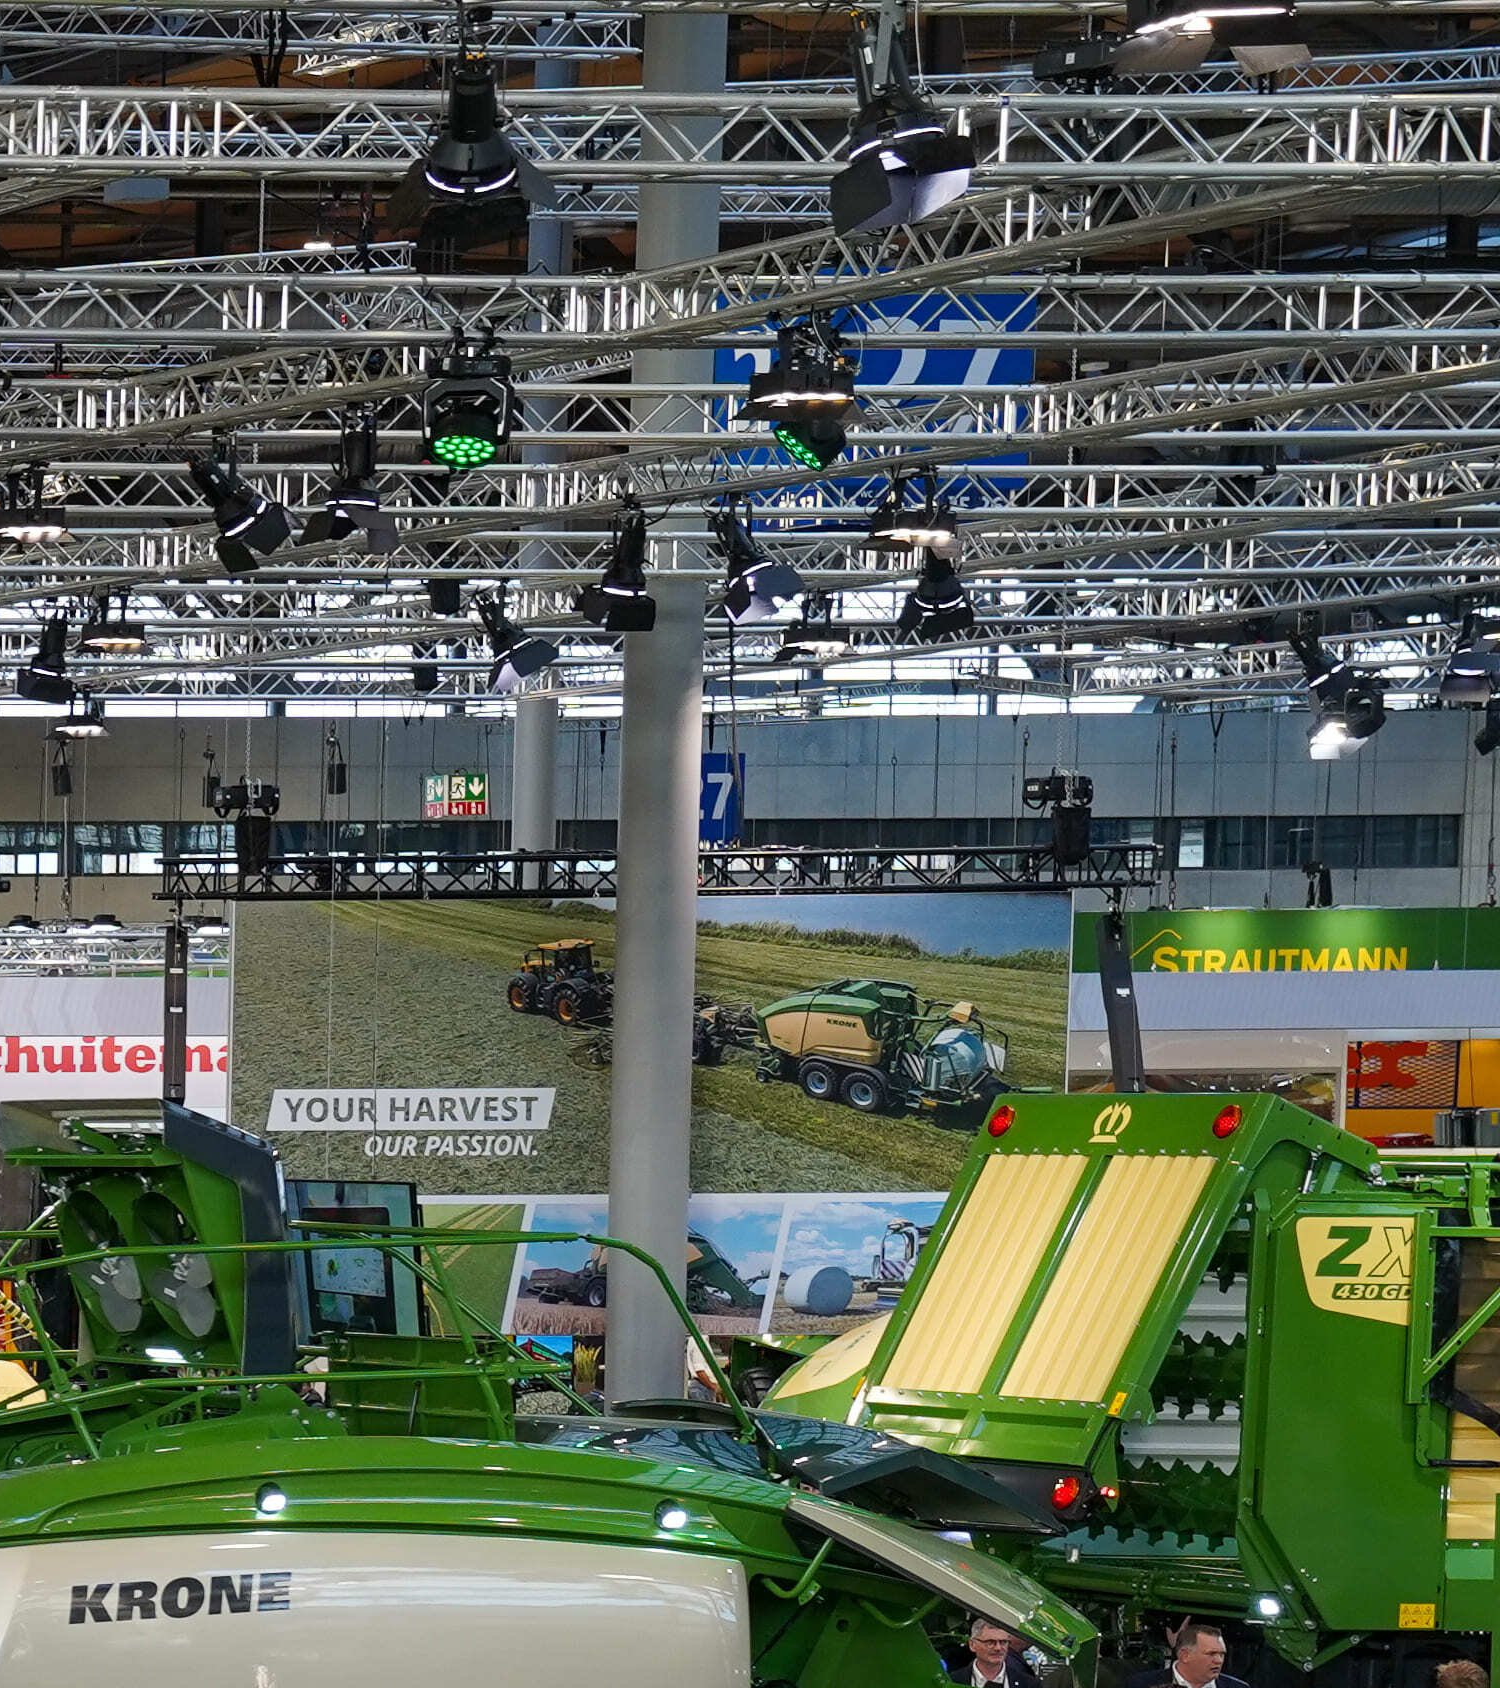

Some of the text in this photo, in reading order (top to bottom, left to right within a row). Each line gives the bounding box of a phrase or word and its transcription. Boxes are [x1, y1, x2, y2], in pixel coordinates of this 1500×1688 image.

[700, 773, 733, 820] 7
[1152, 946, 1408, 972] STRAUTMANN
[826, 1018, 859, 1030] KRONE
[284, 1096, 539, 1123] YOUR HARVEST
[363, 1134, 539, 1157] OUR PASSION.
[1335, 1284, 1380, 1299] 430
[68, 1572, 293, 1625] KRONE
